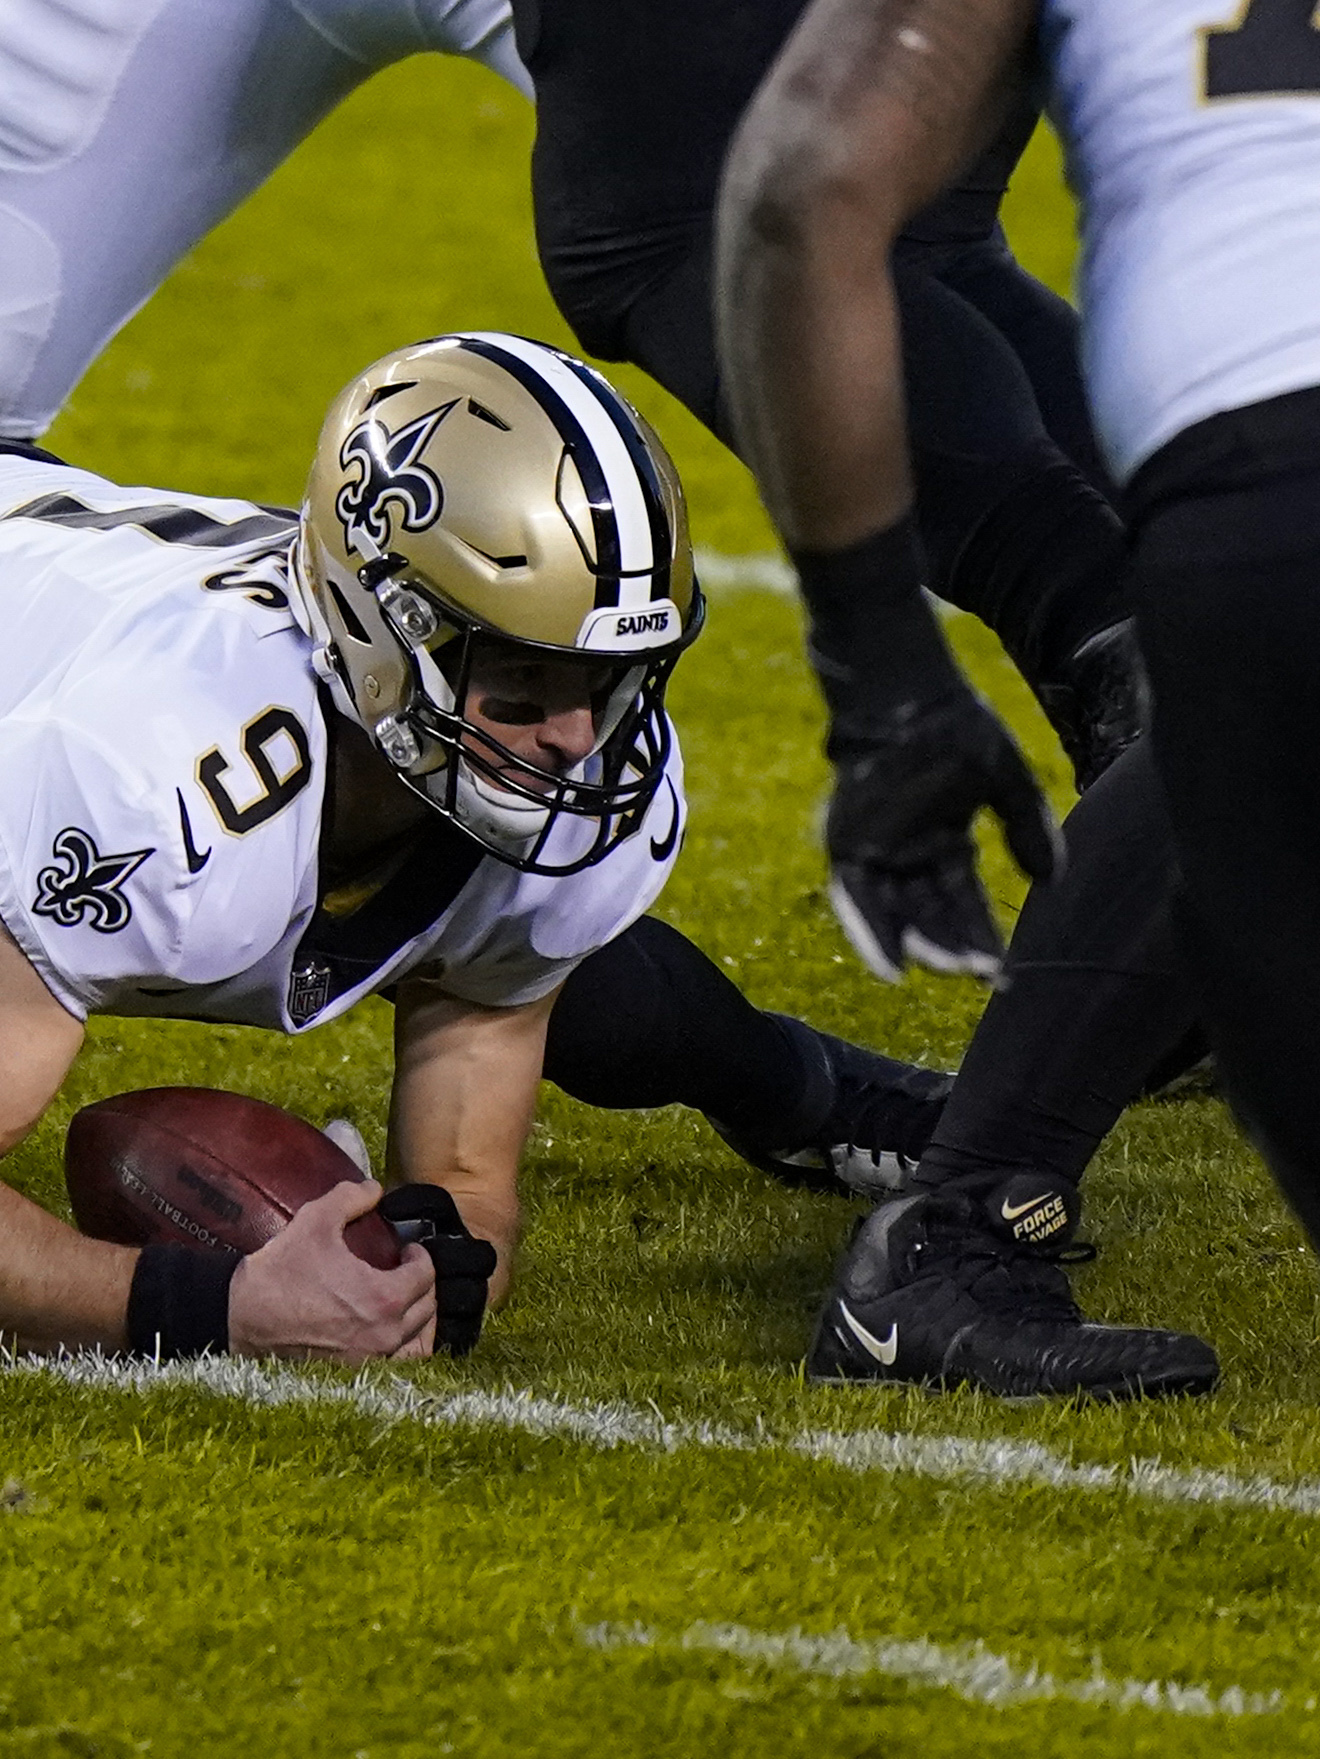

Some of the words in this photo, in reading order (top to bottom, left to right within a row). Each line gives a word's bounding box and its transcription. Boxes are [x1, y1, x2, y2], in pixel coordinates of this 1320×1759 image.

[616, 611, 669, 636] SAINTS
[195, 704, 314, 838] 9
[149, 1192, 218, 1247] FOOTBALL
[1013, 1195, 1064, 1239] FORCE
[1021, 1211, 1068, 1242] AVAGE
